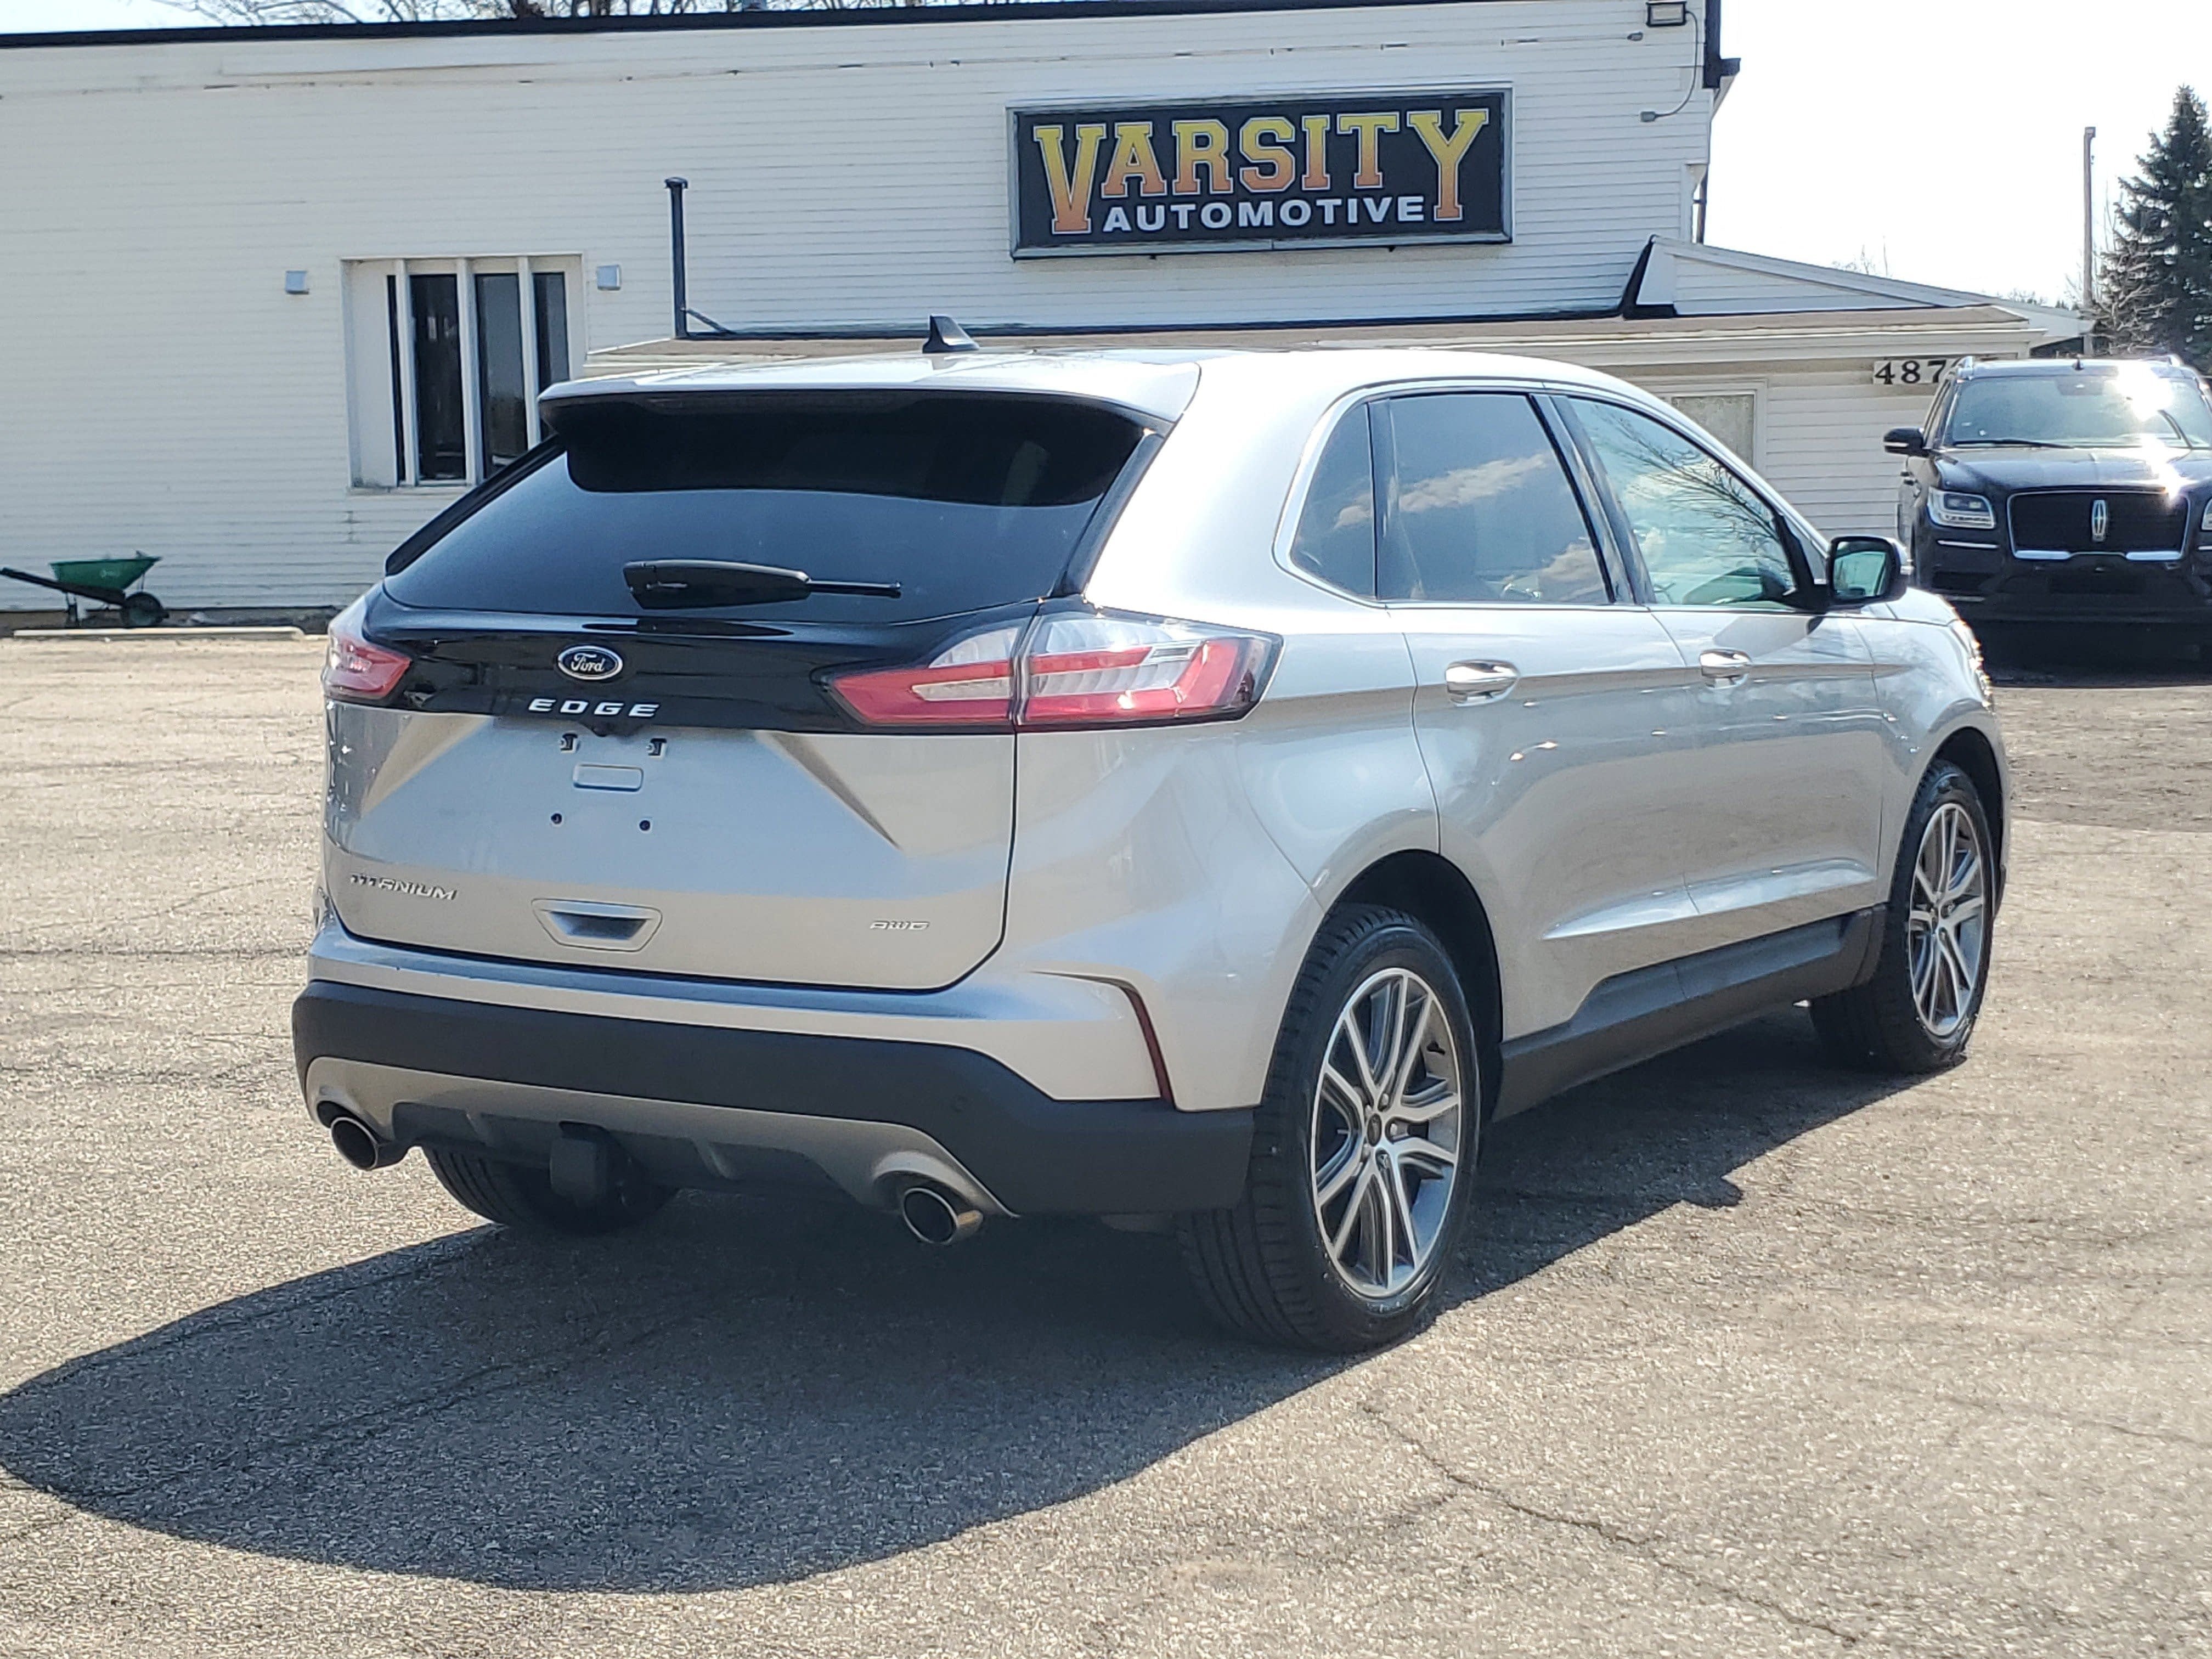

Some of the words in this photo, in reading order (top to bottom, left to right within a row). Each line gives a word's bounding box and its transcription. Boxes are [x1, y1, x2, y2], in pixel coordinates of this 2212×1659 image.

[1034, 109, 1488, 235] VARSITY
[1103, 196, 1425, 233] AUTOMOTIVE
[1875, 358, 1999, 385] 487
[570, 653, 605, 672] Ford
[528, 698, 659, 717] EDGE
[350, 874, 458, 900] TITANIUM
[870, 921, 930, 930] AWD
